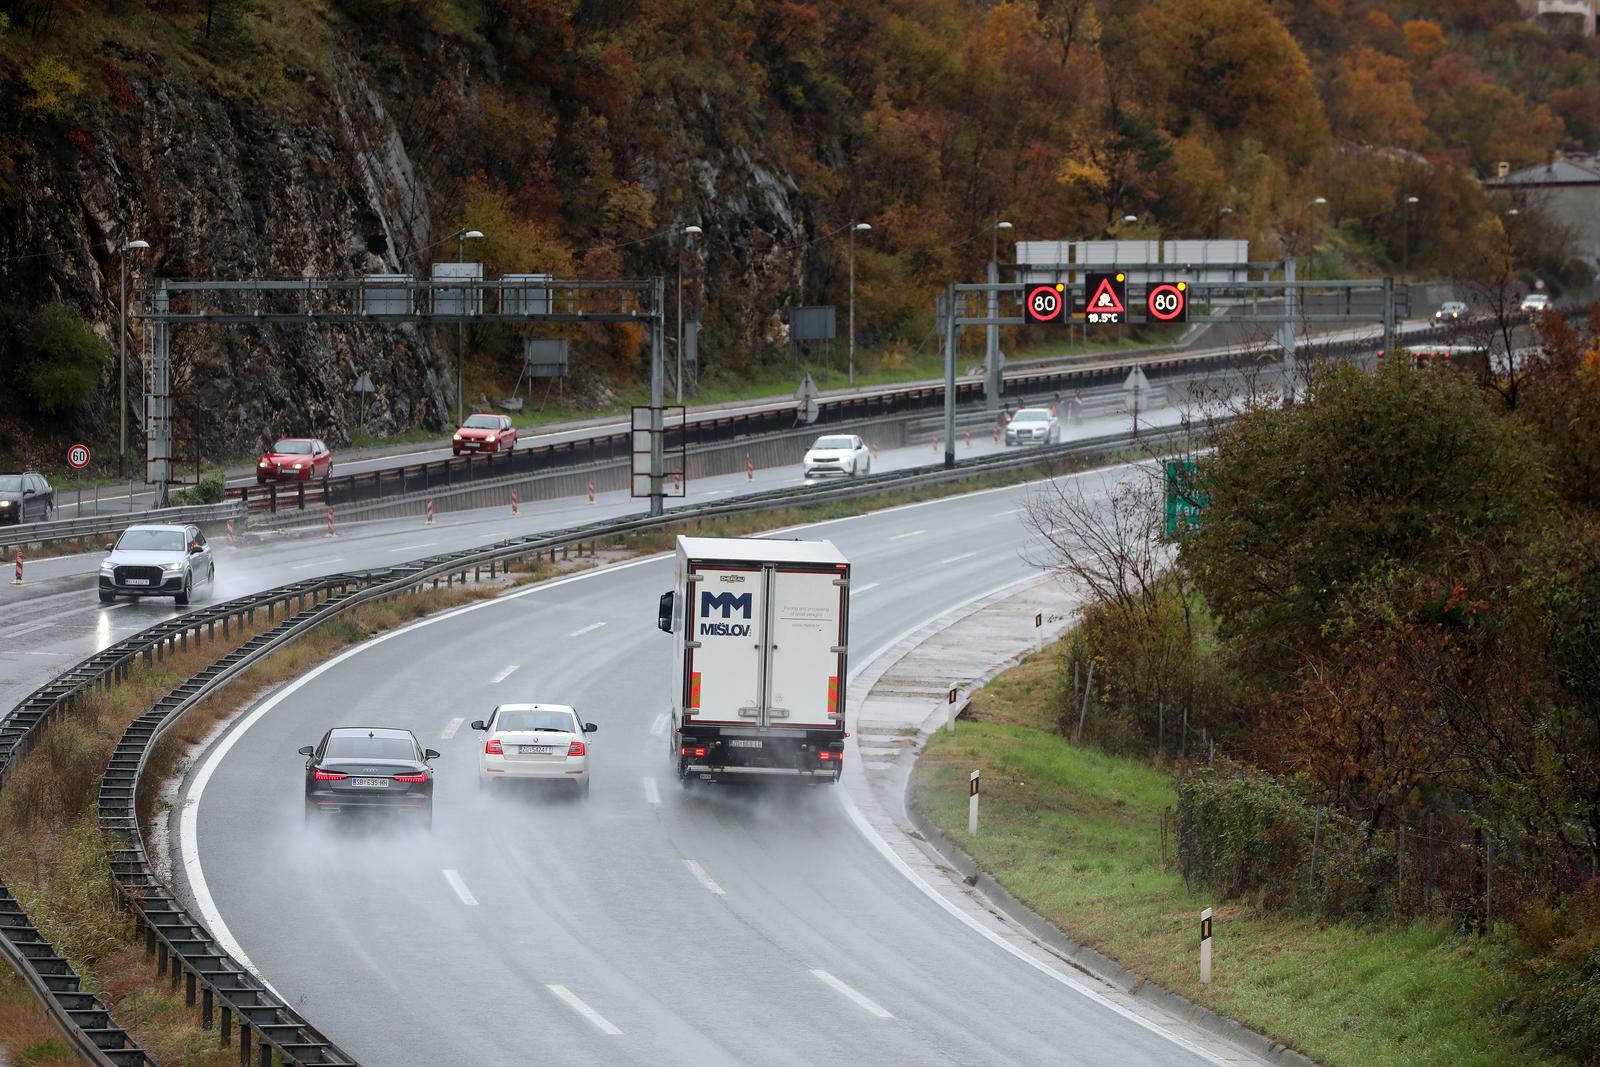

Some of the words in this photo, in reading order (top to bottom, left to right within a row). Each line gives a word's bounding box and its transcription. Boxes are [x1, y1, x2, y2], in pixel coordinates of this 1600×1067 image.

[1034, 296, 1056, 311] 80
[1155, 294, 1177, 310] 80
[73, 450, 85, 462] 60
[700, 622, 751, 637] MIŠLOV
